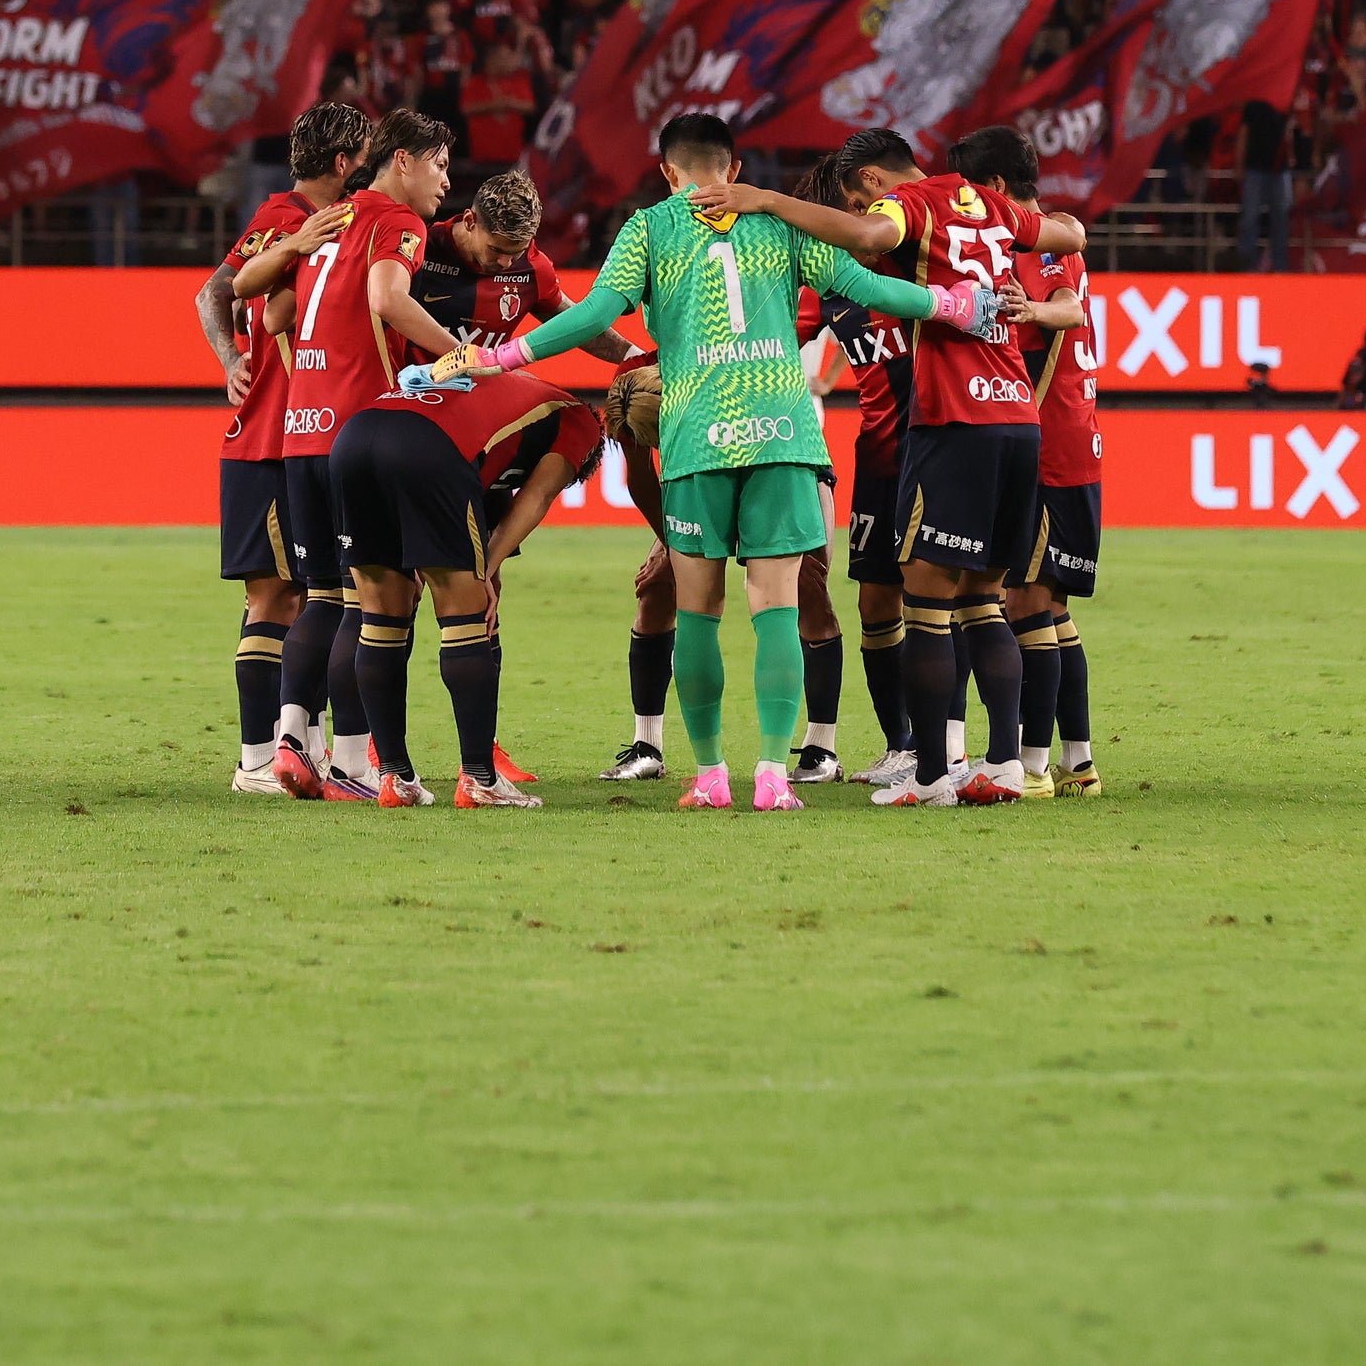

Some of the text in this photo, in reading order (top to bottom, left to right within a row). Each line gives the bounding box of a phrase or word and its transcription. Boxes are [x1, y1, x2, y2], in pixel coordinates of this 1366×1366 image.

[946, 226, 1016, 290] 55
[298, 242, 341, 341] 7
[494, 274, 530, 283] mercari
[707, 241, 746, 333] 1
[981, 322, 1009, 345] EDA
[1096, 285, 1281, 377] IXIL
[296, 348, 327, 371] RYOYA
[696, 338, 786, 366] HAYAKAWA
[840, 326, 907, 367] LIXI
[990, 376, 1031, 403] RISO
[293, 407, 336, 434] RISO
[735, 416, 794, 445] RISO
